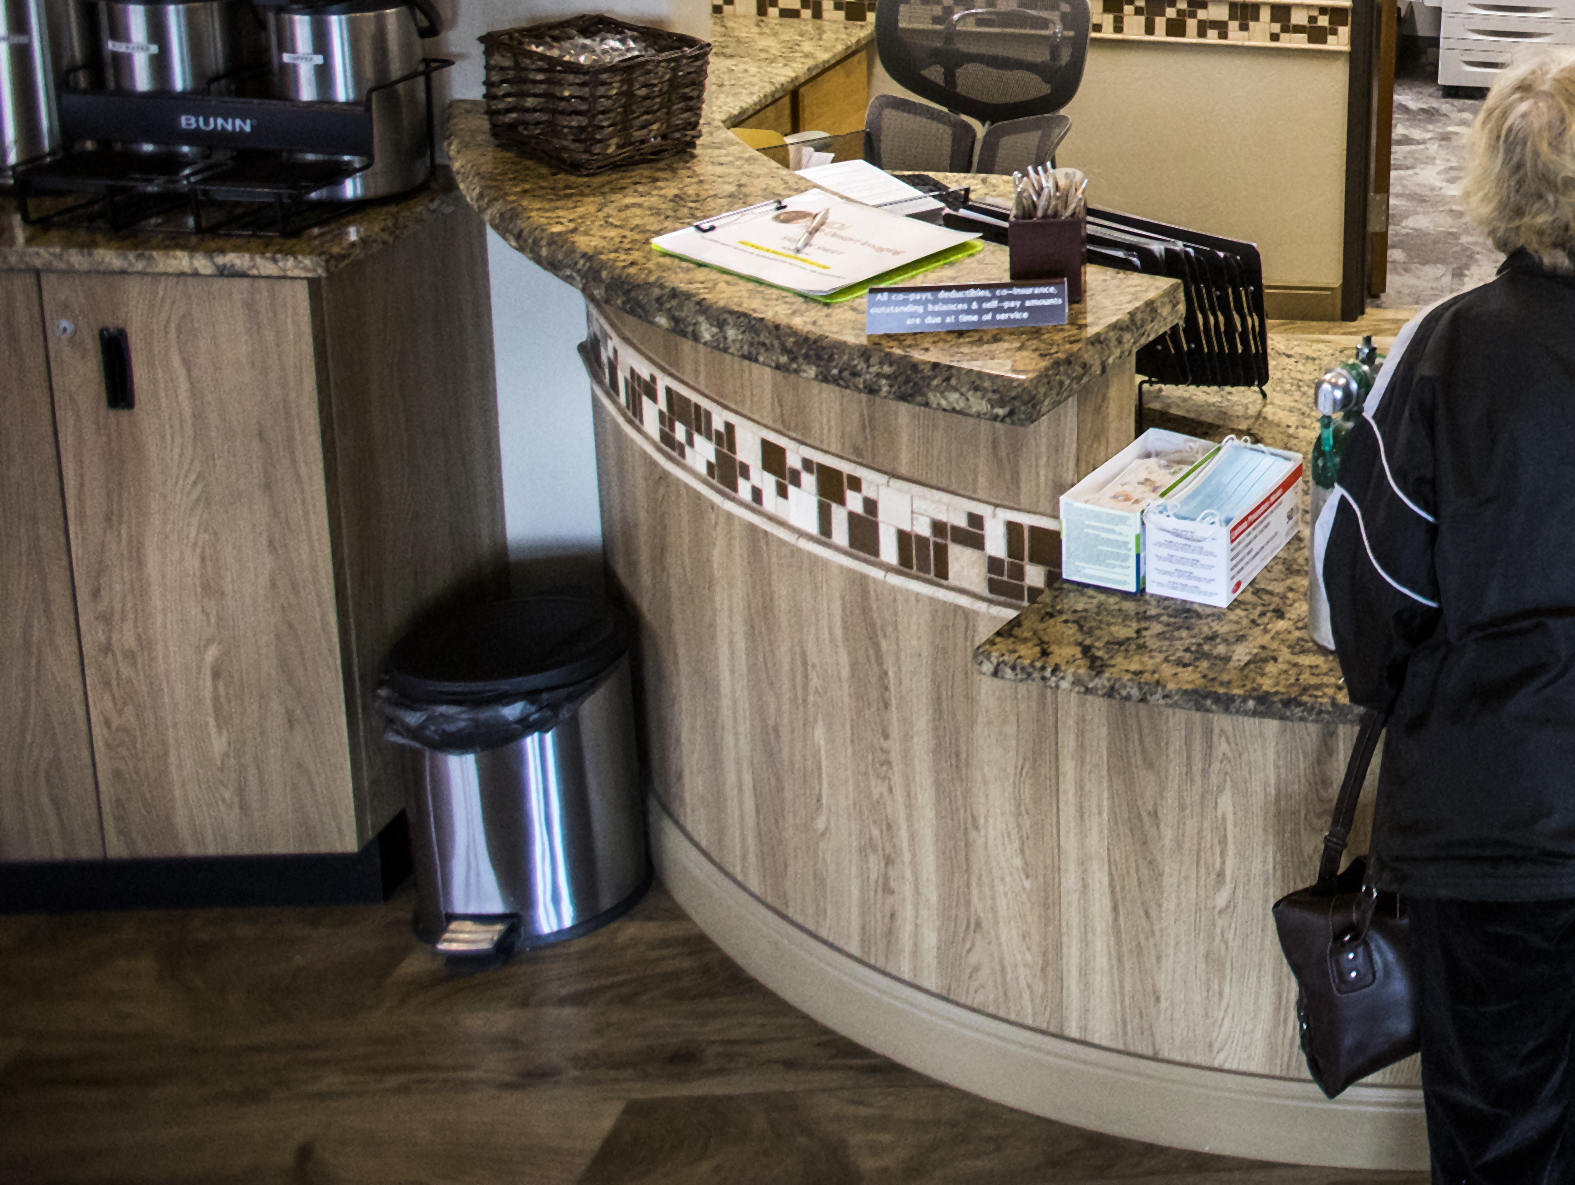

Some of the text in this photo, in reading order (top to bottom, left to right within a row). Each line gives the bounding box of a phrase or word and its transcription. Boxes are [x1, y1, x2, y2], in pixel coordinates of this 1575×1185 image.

[181, 115, 251, 132] BUNN
[875, 292, 888, 301] All
[870, 303, 924, 314] outstanding
[927, 302, 968, 311] balances
[982, 299, 1021, 310] self-pay
[1025, 297, 1062, 307] amounts
[924, 315, 942, 324] due
[945, 315, 955, 323] at
[958, 314, 979, 323] time
[982, 312, 992, 321] of
[995, 311, 1029, 320] service
